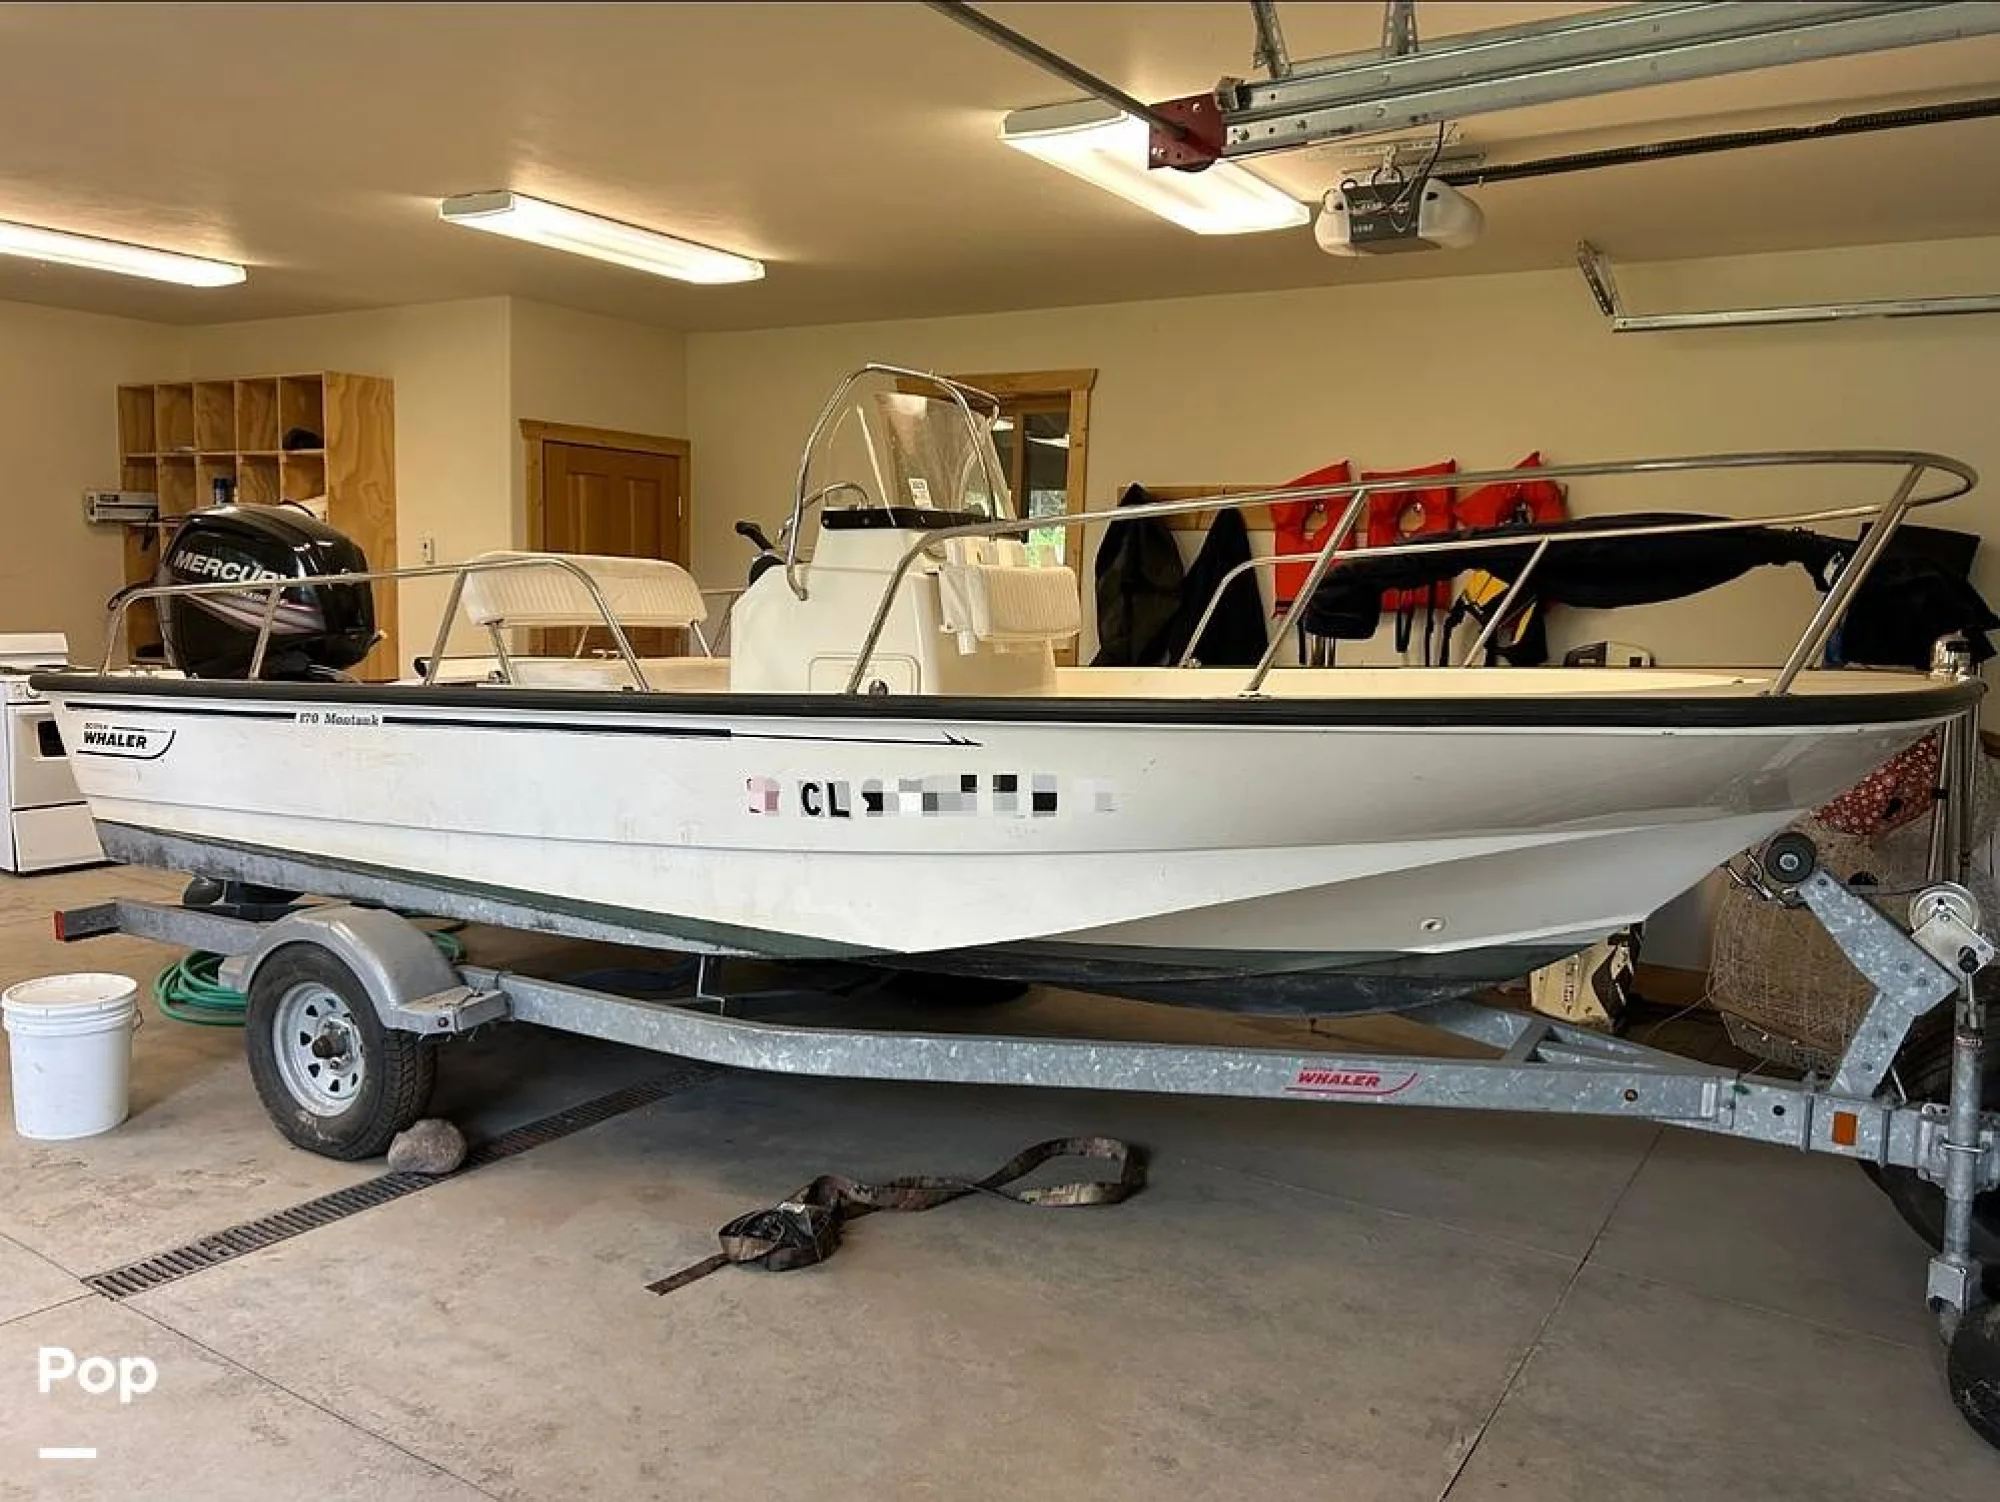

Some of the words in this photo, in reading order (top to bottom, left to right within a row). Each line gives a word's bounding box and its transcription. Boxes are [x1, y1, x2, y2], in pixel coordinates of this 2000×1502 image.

[174, 550, 287, 587] MERCUR
[83, 731, 147, 749] WHALER
[801, 782, 850, 818] CL
[1298, 1071, 1381, 1087] WHALER
